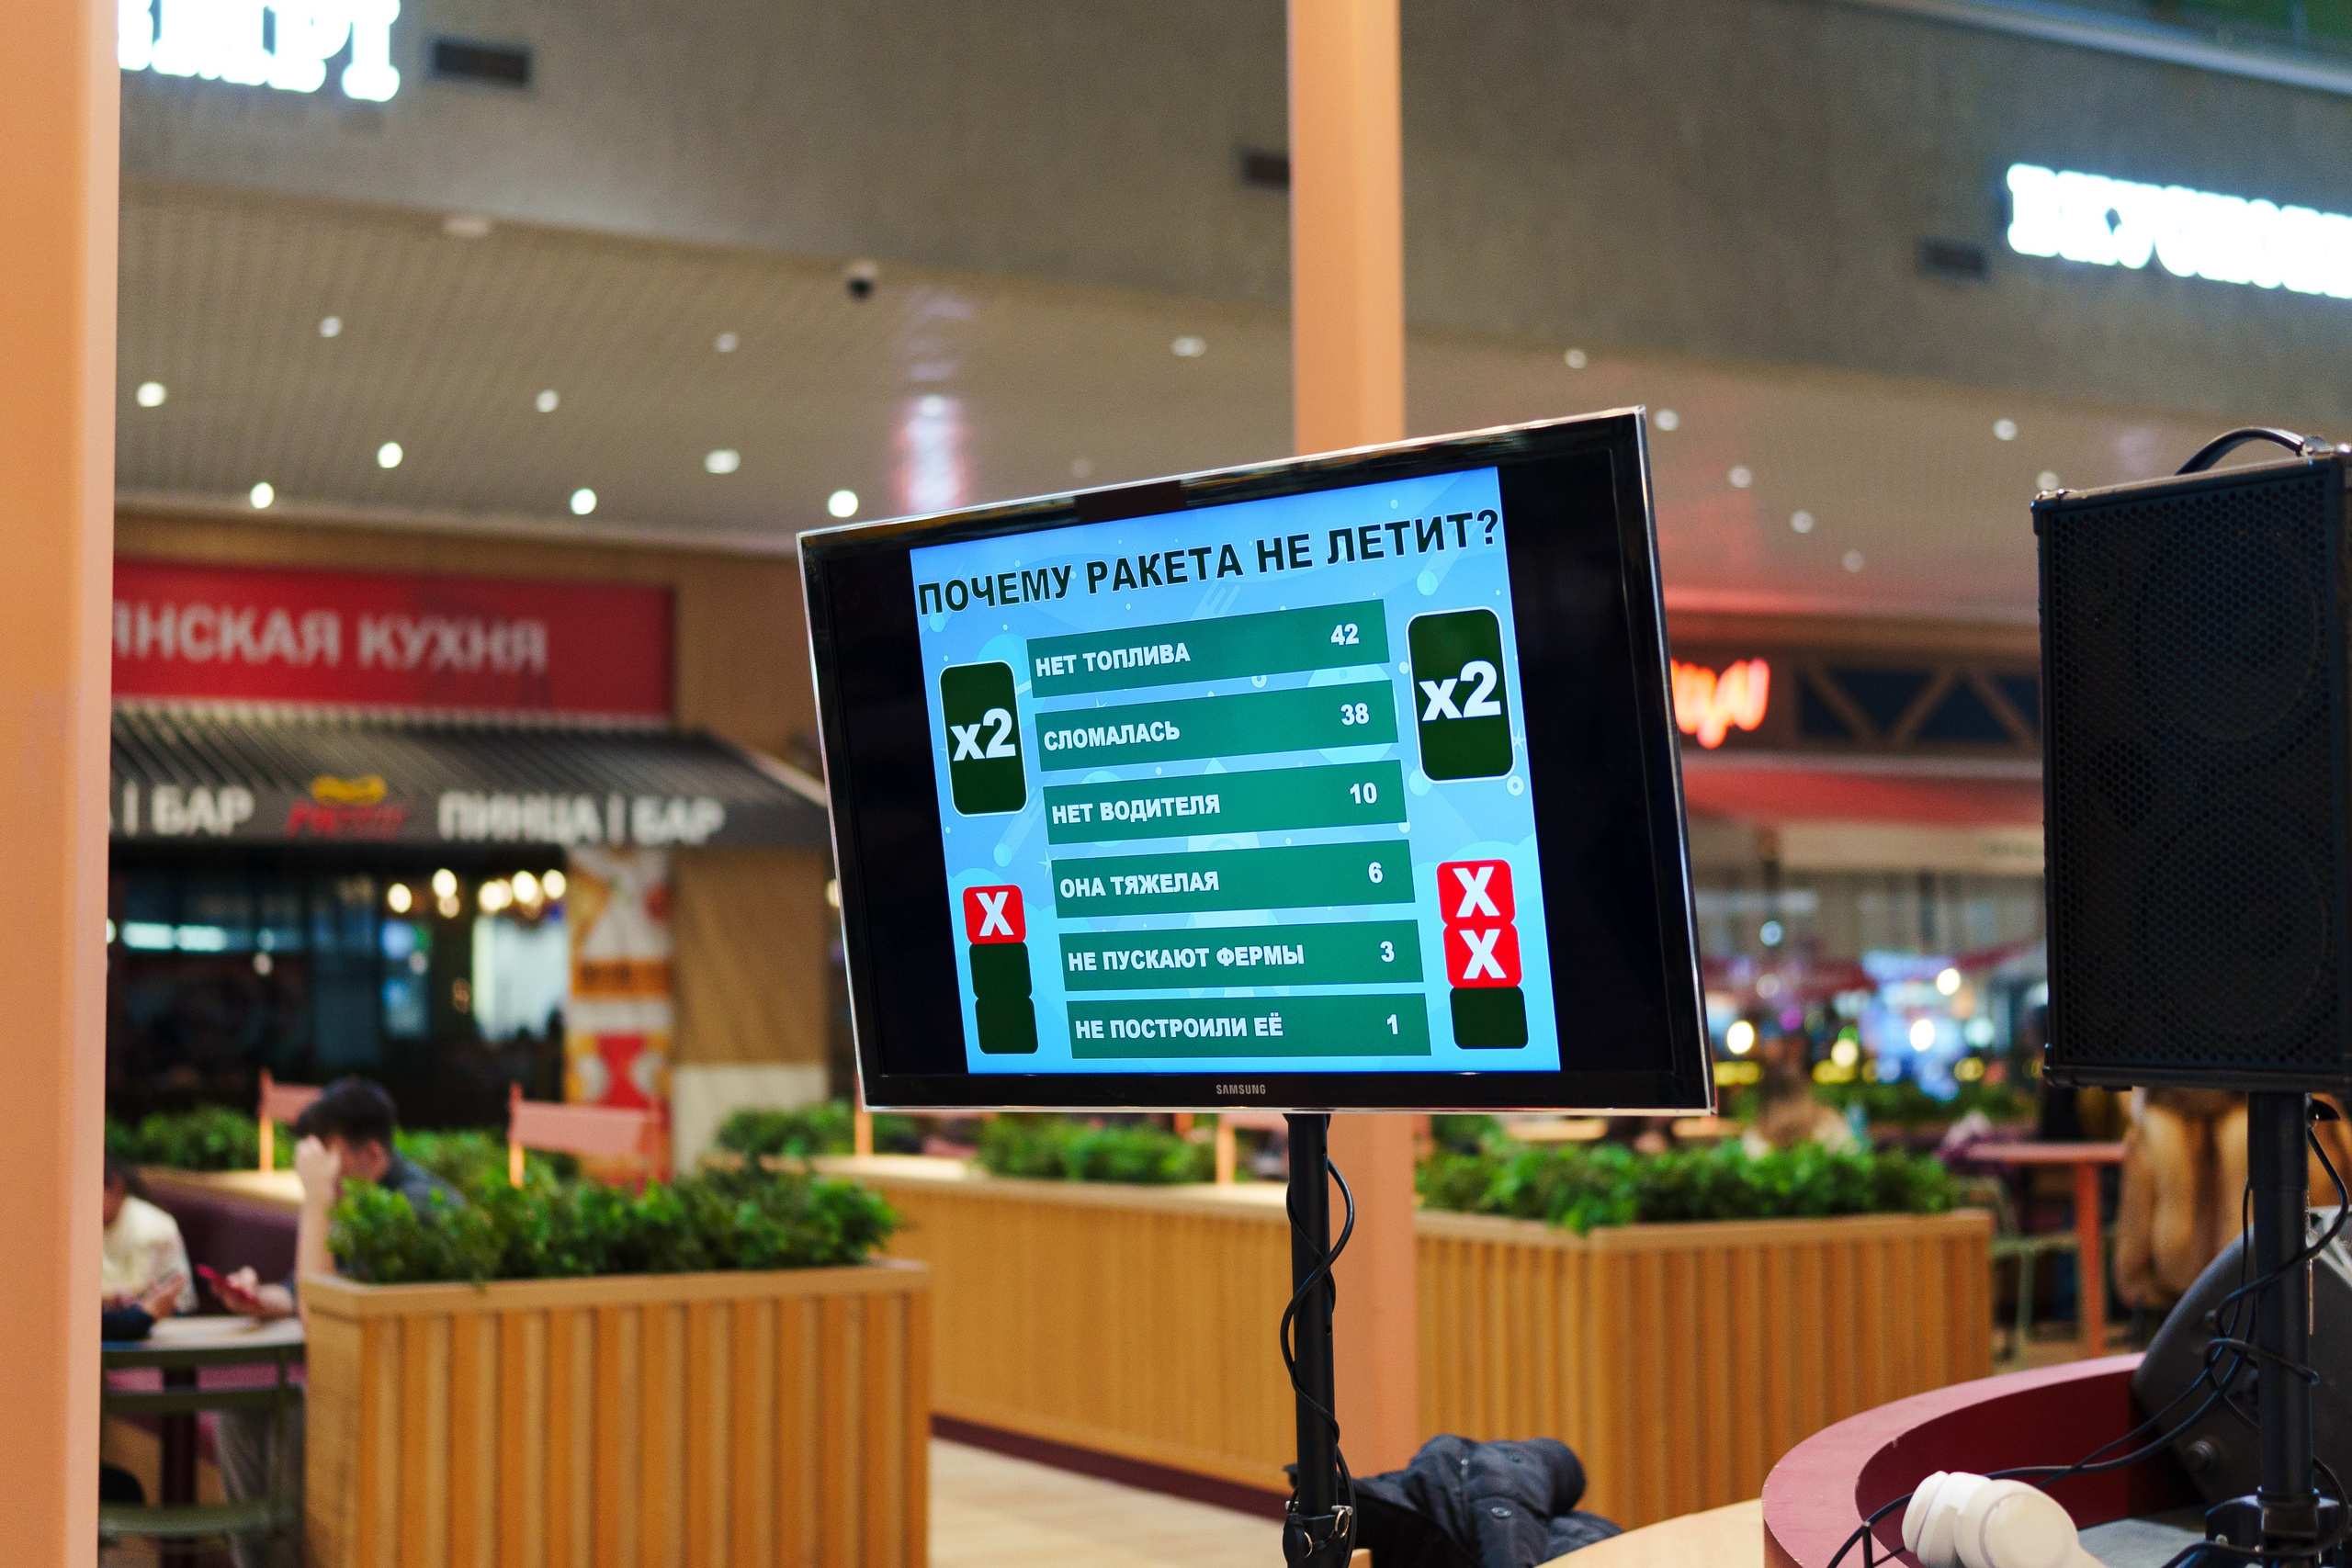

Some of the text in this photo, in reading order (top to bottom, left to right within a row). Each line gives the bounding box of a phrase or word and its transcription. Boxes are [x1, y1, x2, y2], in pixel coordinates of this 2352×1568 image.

[919, 508, 1499, 615] ПОЧЕМУ РАКЕТА НЕ ЛЕТИТ?
[356, 612, 549, 673] КУХНЯ
[1329, 622, 1361, 647] 42
[1035, 642, 1192, 678] НЕТ ТОПЛИВА
[1340, 702, 1371, 727] 38
[1043, 719, 1182, 752] СЛОМАЛАСЬ
[1349, 781, 1378, 805] 10
[150, 784, 256, 838] БАР
[629, 794, 727, 846] БАР
[1051, 793, 1221, 826] НЕТ ВОДИТЕЛЯ
[1059, 870, 1220, 899] ОНА ТЯЖЕЛАЯ
[1367, 861, 1385, 885] 6
[1067, 943, 1306, 973] НЕ ПУСКАЮТ ФЕРМЫ
[1379, 940, 1396, 964] 3
[1074, 1010, 1284, 1040] НЕ ПОСТРОИЛИ ЕЁ
[1385, 1013, 1399, 1036] 1
[1215, 1083, 1267, 1096] SAMSUNG
